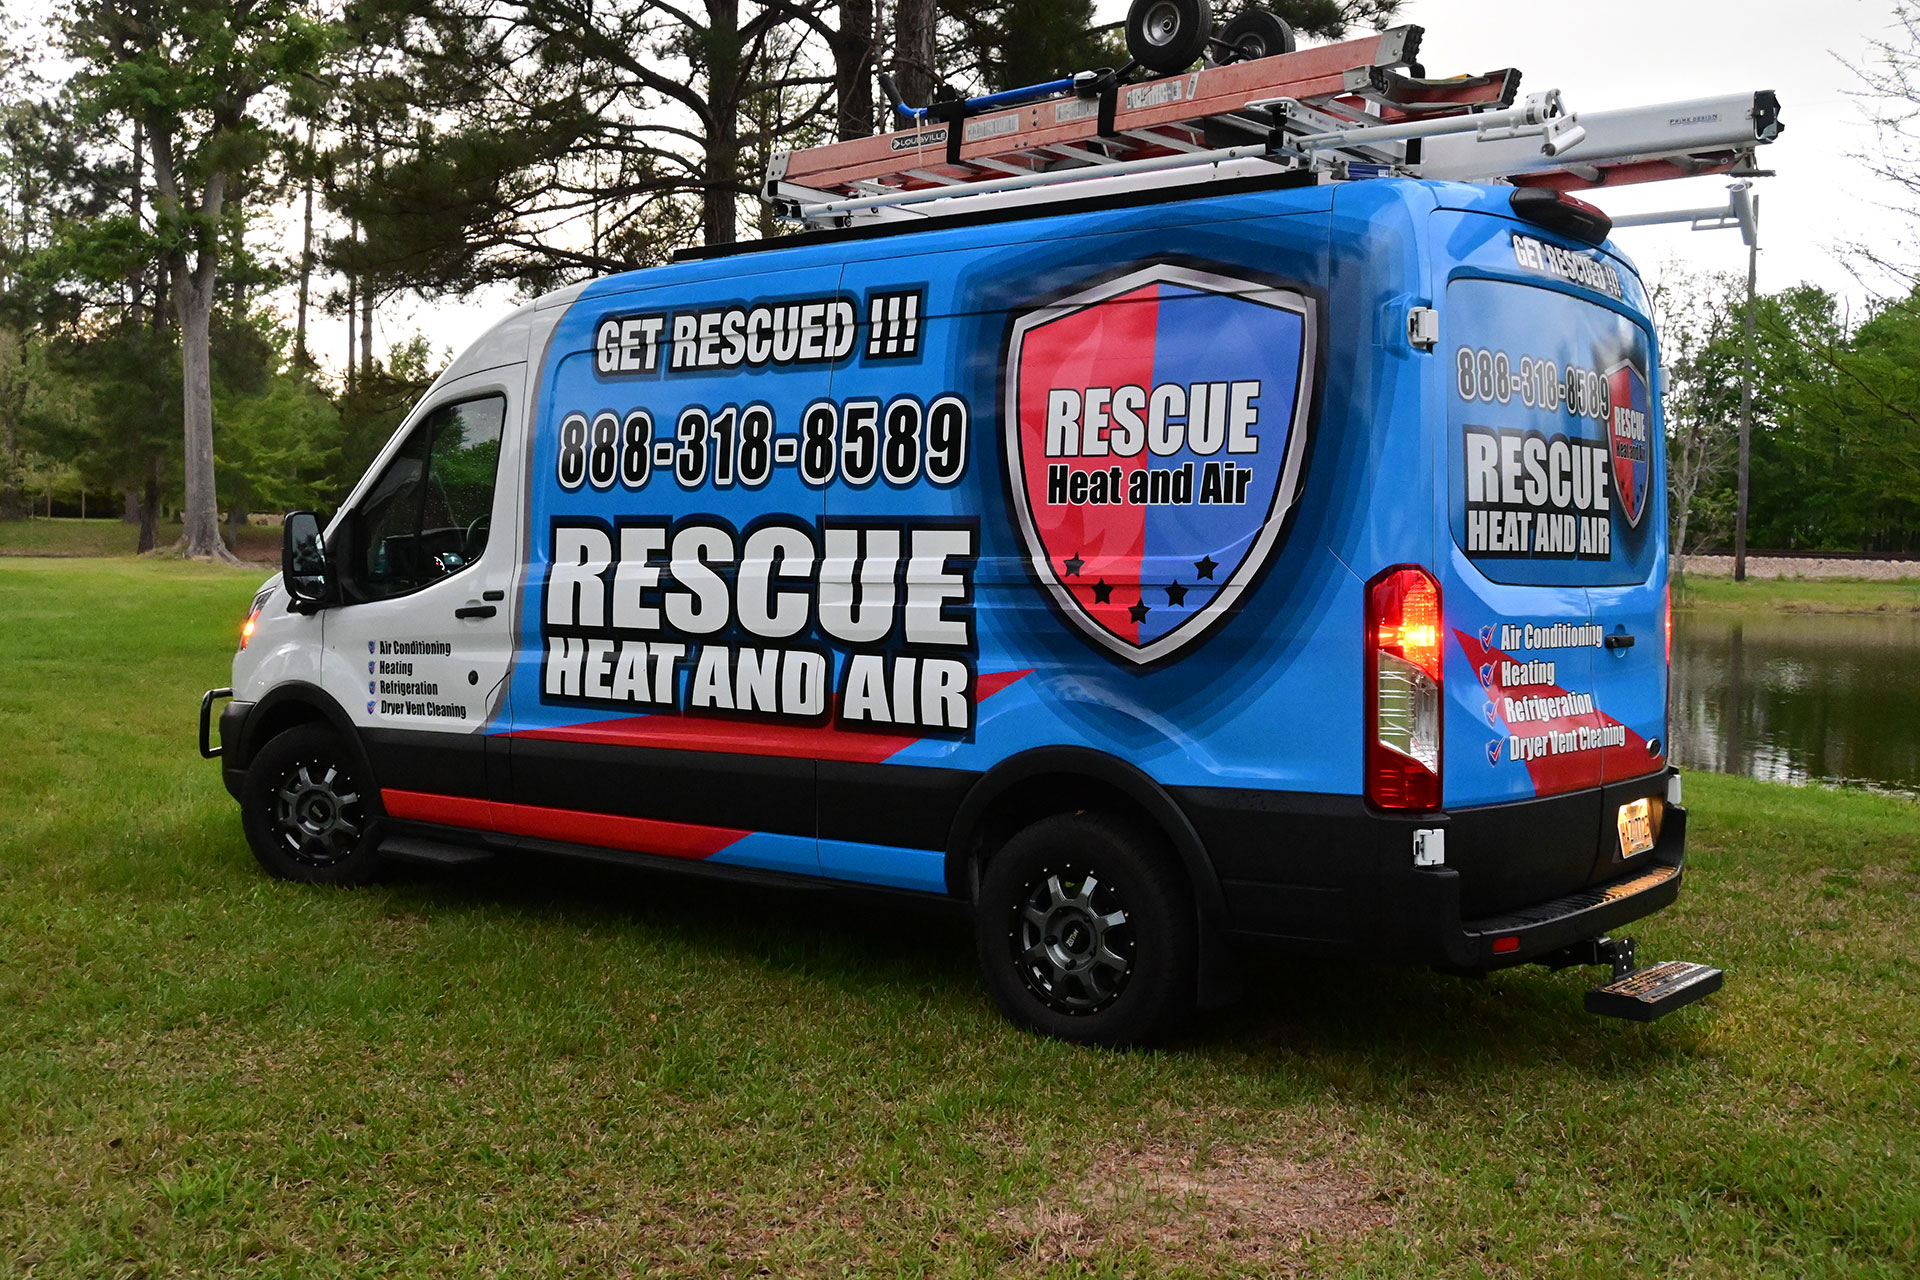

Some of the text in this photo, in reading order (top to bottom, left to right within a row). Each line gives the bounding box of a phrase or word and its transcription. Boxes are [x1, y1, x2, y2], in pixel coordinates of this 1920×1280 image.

[900, 131, 946, 147] LOUSVILLE
[1512, 234, 1622, 297] GET RESCUED !!!
[597, 295, 919, 373] GET RESCUED !!!
[1456, 346, 1611, 420] 888-318-8589
[1045, 380, 1261, 458] RESCUE
[1614, 406, 1646, 442] RESCUE
[558, 396, 969, 489] 888-318-8589
[1047, 461, 1253, 505] Heat and Air
[1466, 432, 1610, 511] RESCUE
[1468, 510, 1610, 555] HEAT AND AIR
[547, 526, 971, 646] RESCUE
[379, 640, 451, 657] Air Conditioning
[1500, 622, 1603, 651] Air Conditioning
[379, 660, 413, 677] Heating
[380, 680, 438, 696] Refrigeration
[545, 636, 969, 729] HEAT AND AIR
[1501, 659, 1556, 687] Heating
[381, 700, 467, 719] Dryer Vent Cleaning
[1504, 691, 1594, 723] Refrigeration
[1509, 723, 1626, 762] Dryer Vent Cleaning
